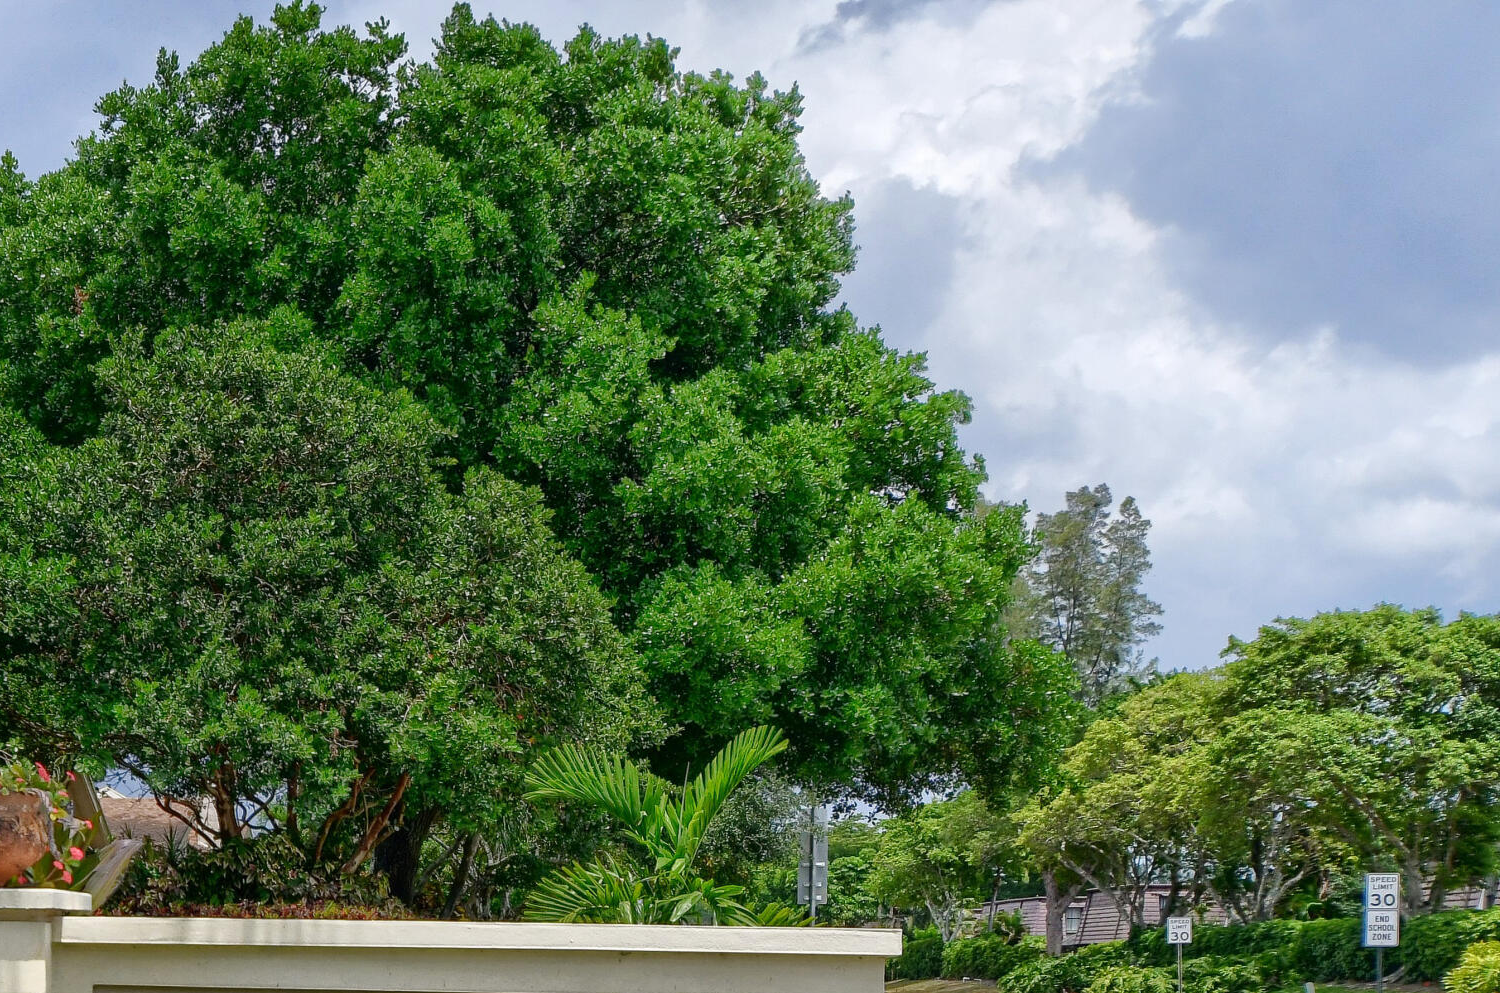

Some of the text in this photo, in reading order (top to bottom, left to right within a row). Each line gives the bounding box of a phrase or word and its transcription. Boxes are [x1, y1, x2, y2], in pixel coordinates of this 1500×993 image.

[1370, 893, 1396, 906] 30
[1375, 915, 1390, 923] END
[1170, 931, 1189, 941] 30
